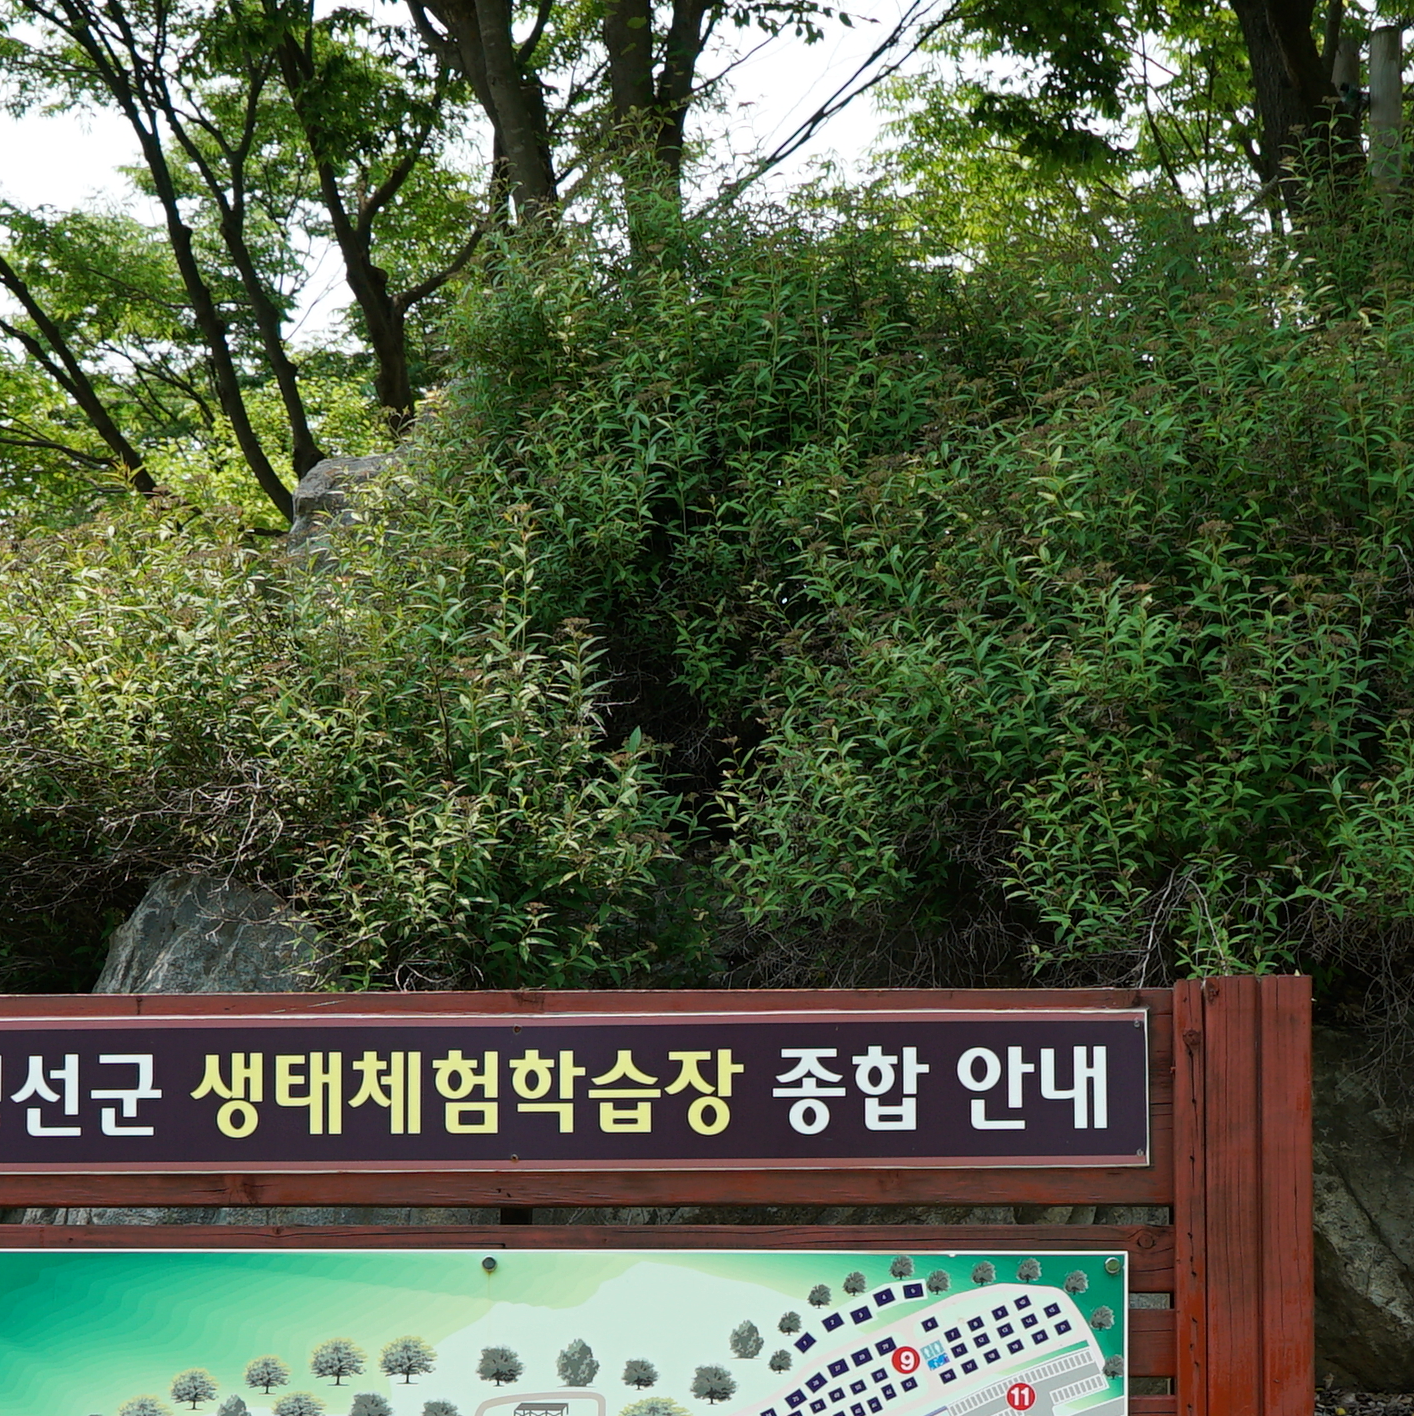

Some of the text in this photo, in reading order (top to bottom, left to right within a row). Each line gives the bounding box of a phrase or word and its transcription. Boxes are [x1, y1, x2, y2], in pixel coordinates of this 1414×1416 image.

[190, 1049, 744, 1138] 생태체험학습장
[773, 1046, 929, 1134] 종합
[957, 1046, 1107, 1129] 안내
[901, 1351, 914, 1370] 9
[1010, 1387, 1030, 1406] 11
